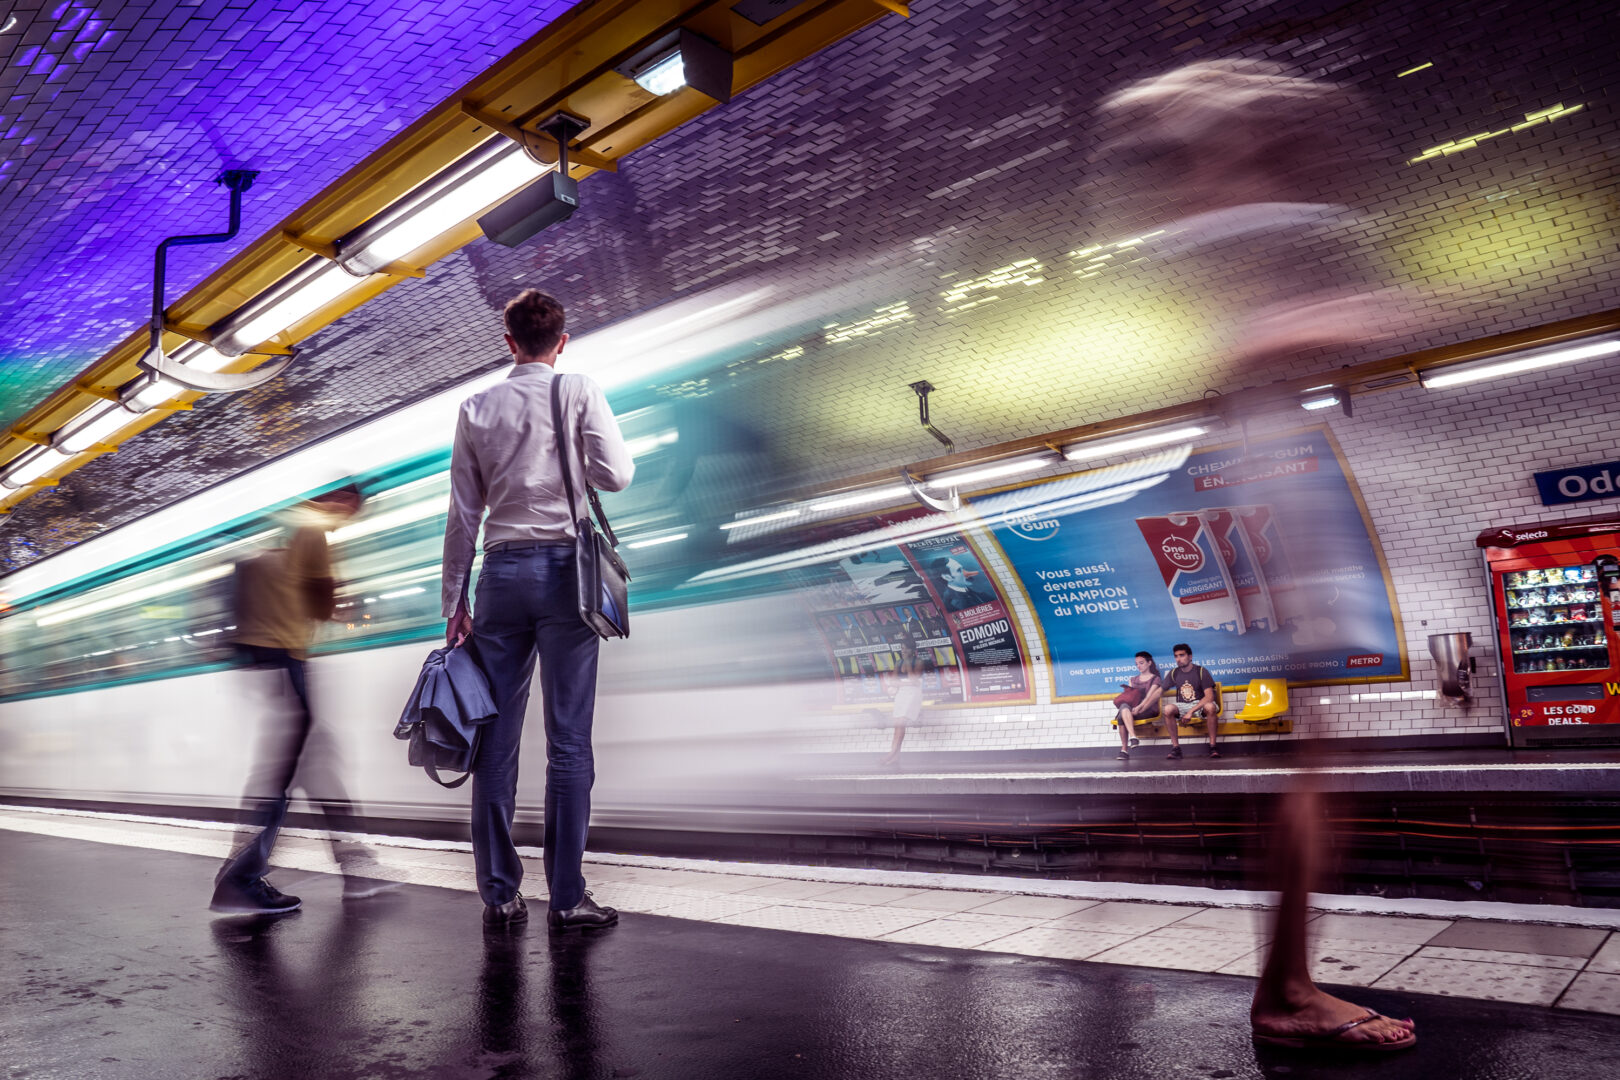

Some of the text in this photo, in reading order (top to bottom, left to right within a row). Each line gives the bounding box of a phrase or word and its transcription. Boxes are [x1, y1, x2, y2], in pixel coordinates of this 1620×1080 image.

[1187, 444, 1313, 476] CHEW-GUM
[1557, 469, 1620, 497] Od
[1020, 518, 1061, 532] Gum
[1515, 530, 1548, 541] selecta
[1161, 545, 1185, 553] One
[1173, 552, 1199, 560] Gum
[1036, 562, 1115, 580] Vous aussi,
[1043, 578, 1101, 592] devenez
[1048, 586, 1128, 604] CHAMPION
[1054, 598, 1139, 617] du MONDE !
[959, 619, 1009, 644] EDMOND
[1101, 666, 1115, 674] EST
[1116, 665, 1137, 673] DISPO
[1217, 657, 1246, 665] (BONS)
[1247, 654, 1289, 662] MAGASINS
[1211, 664, 1283, 675] WWW.ONEGUM.EU
[1284, 663, 1307, 671] CODE
[1308, 660, 1339, 669] PROMO
[1350, 656, 1381, 665] METRO
[1543, 706, 1563, 715] LES
